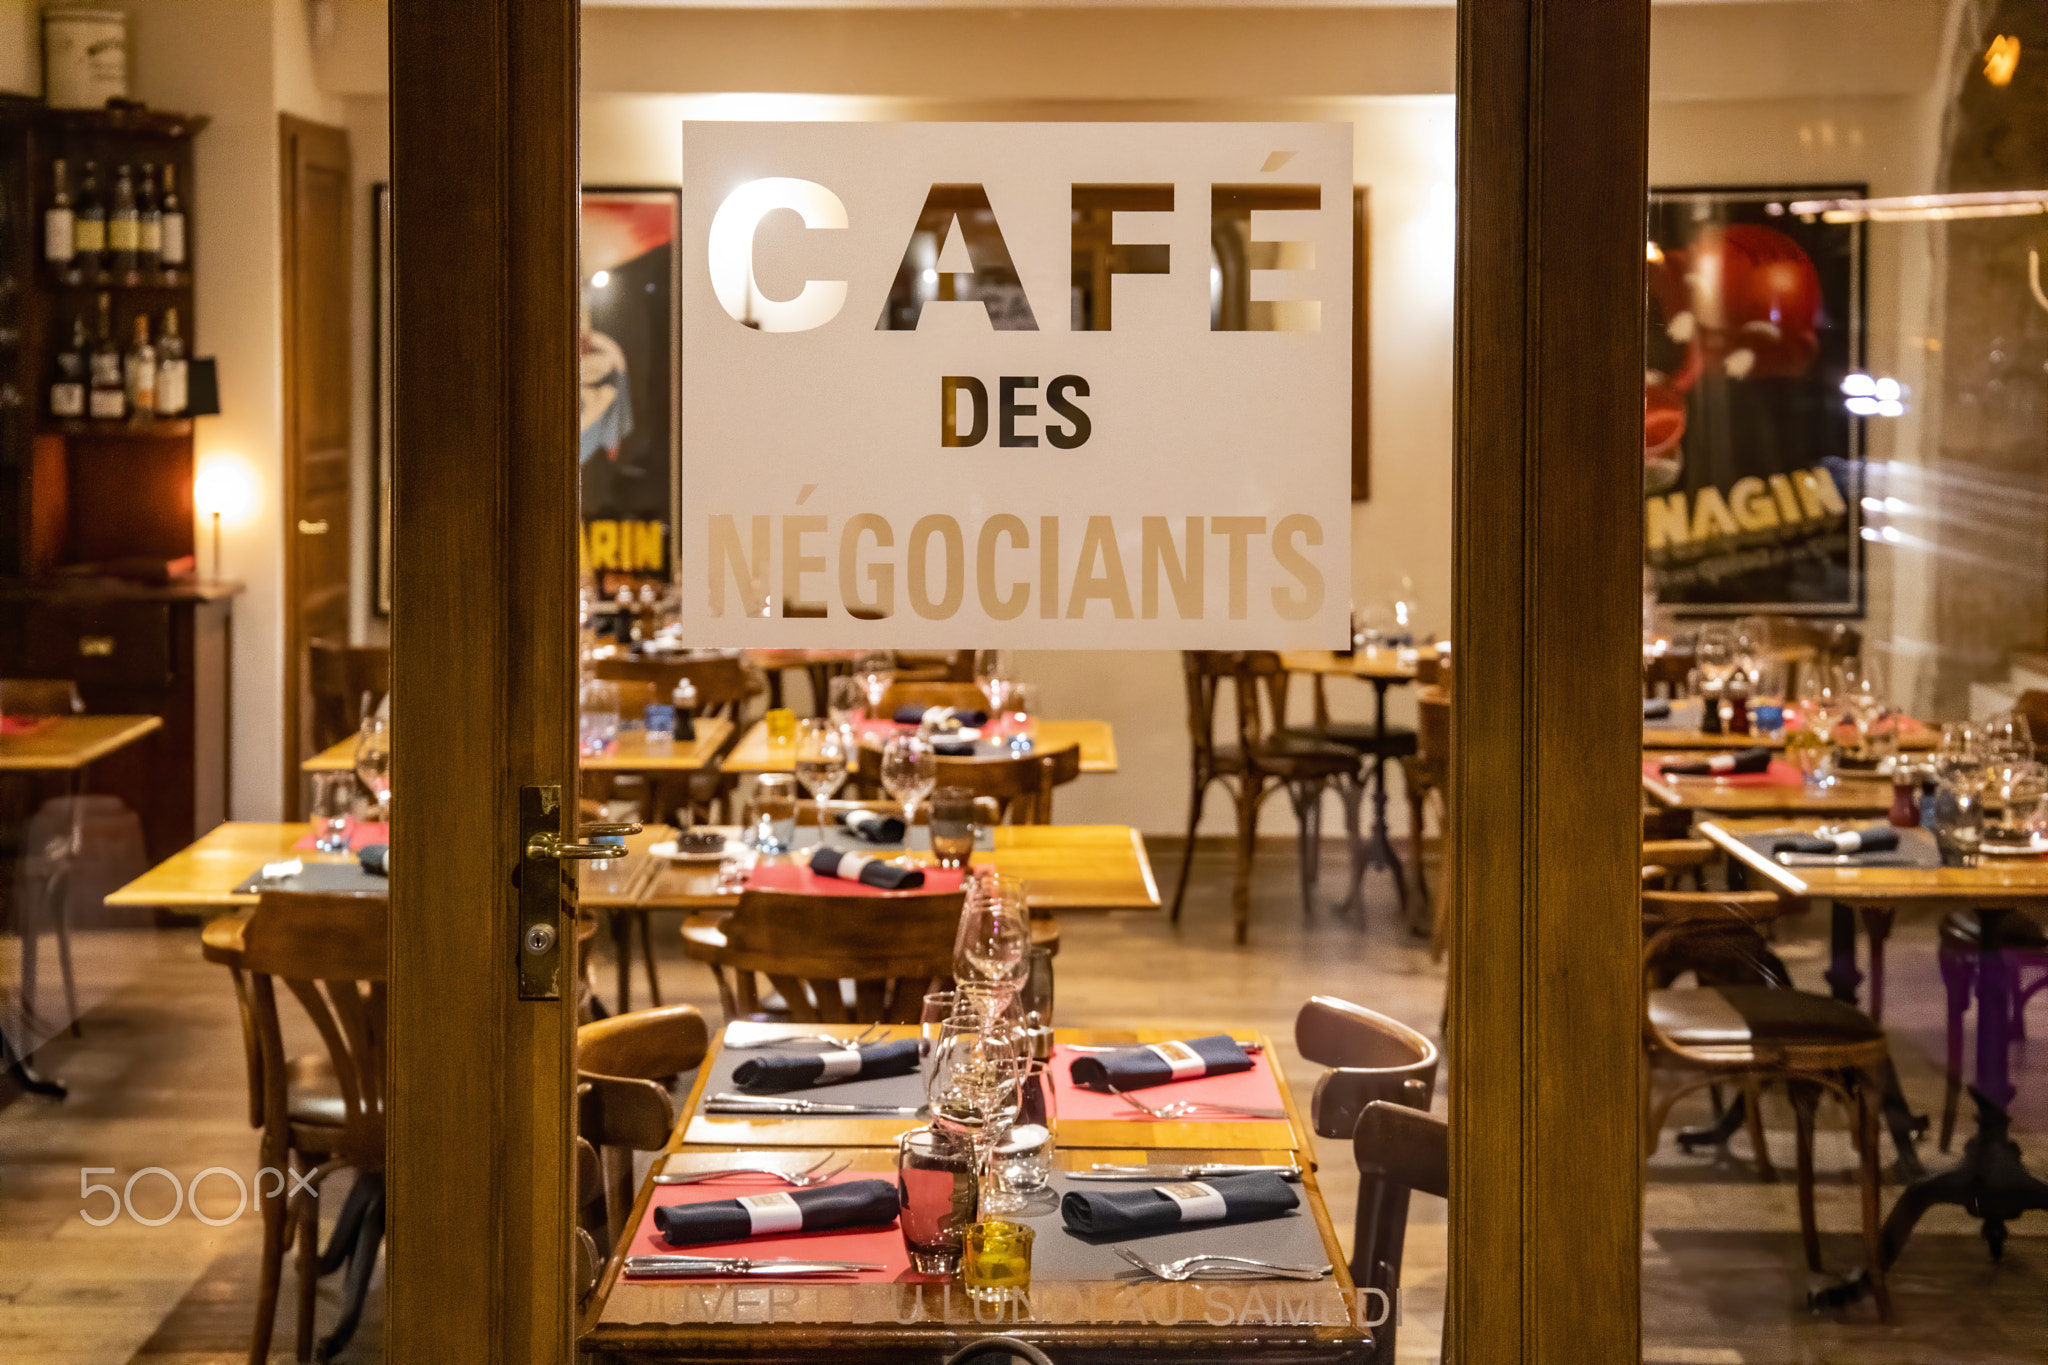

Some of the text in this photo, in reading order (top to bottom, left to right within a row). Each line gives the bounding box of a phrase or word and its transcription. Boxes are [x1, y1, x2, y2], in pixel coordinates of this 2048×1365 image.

[708, 151, 1321, 333] CAFÉ
[941, 374, 1092, 449] DES
[707, 484, 1326, 621] NÉGOCIANTS
[944, 1285, 1098, 1325] LUNDI
[1113, 1285, 1183, 1325] AU
[1203, 1286, 1402, 1327] SAMEDI
